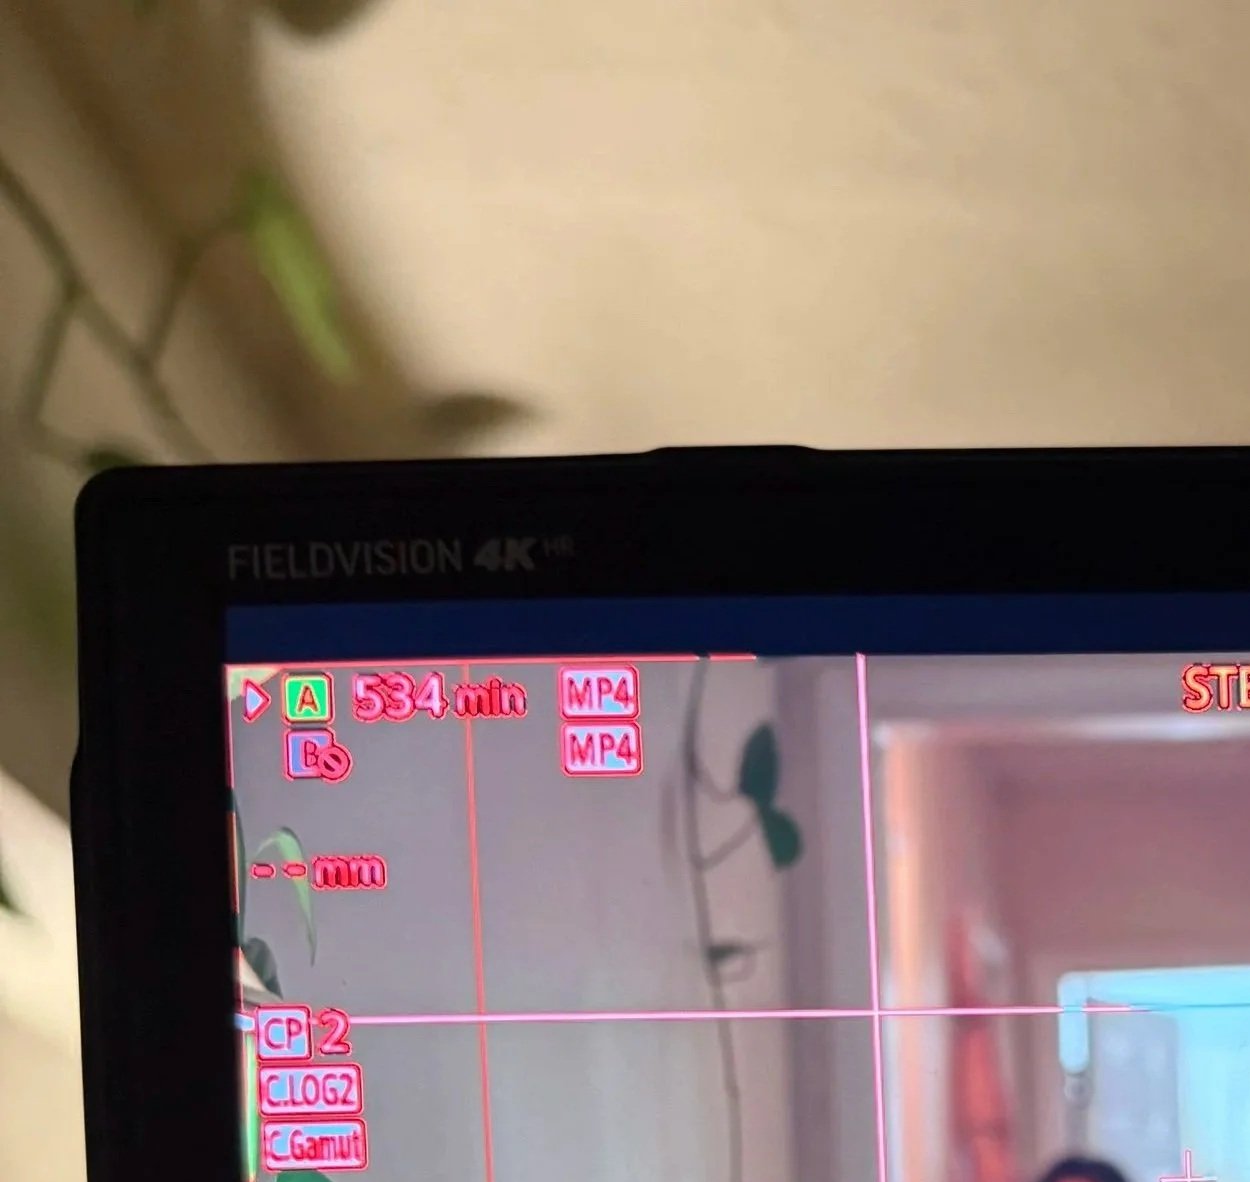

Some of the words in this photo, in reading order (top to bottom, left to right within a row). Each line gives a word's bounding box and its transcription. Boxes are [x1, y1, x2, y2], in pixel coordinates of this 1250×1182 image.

[227, 538, 464, 581] FIELDVISION
[353, 672, 449, 722] 534
[454, 677, 527, 718] min
[566, 676, 636, 711] MP4
[568, 733, 638, 767] MP4
[262, 1017, 303, 1051] CP
[317, 1008, 353, 1056] 2
